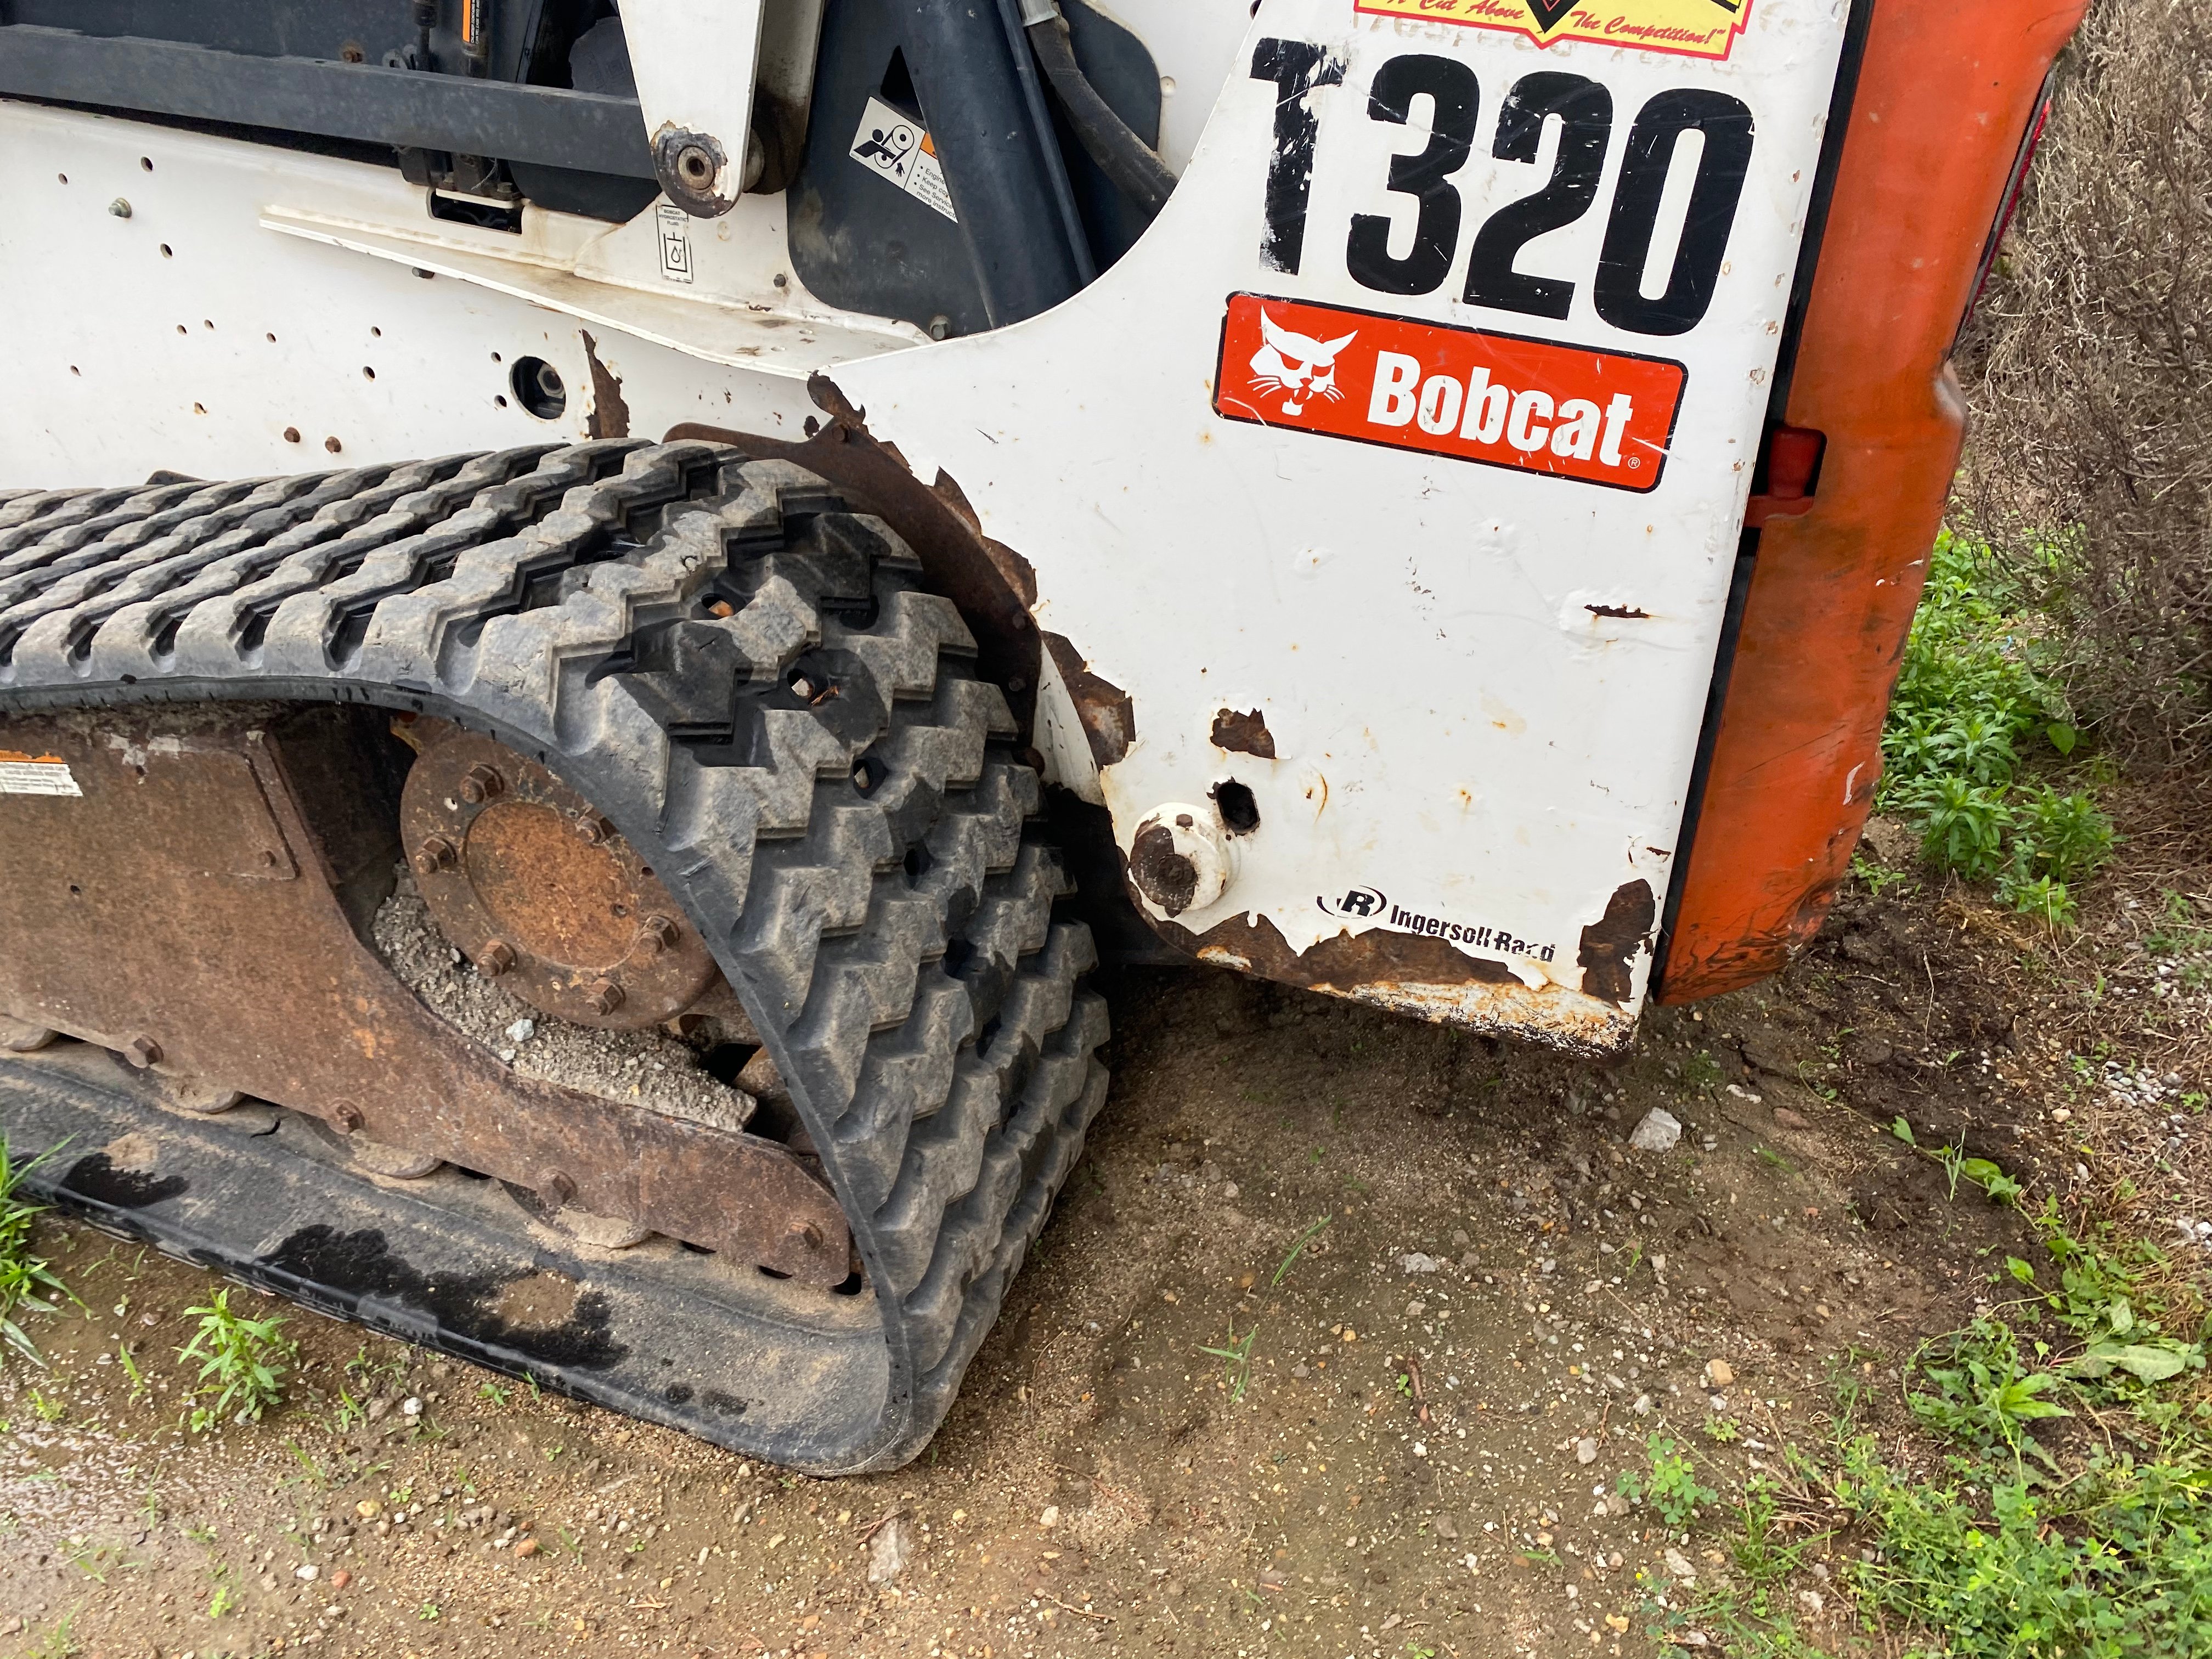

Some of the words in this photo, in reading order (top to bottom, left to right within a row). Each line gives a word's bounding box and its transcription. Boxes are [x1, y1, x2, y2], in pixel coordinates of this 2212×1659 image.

[1465, 0, 1524, 19] Above
[1570, 10, 1601, 30] The
[922, 176, 938, 190] Keep
[926, 168, 945, 184] Engine
[919, 184, 930, 195] See
[1249, 37, 1754, 336] T320
[917, 191, 932, 203] more
[1367, 349, 1634, 467] Bobcat
